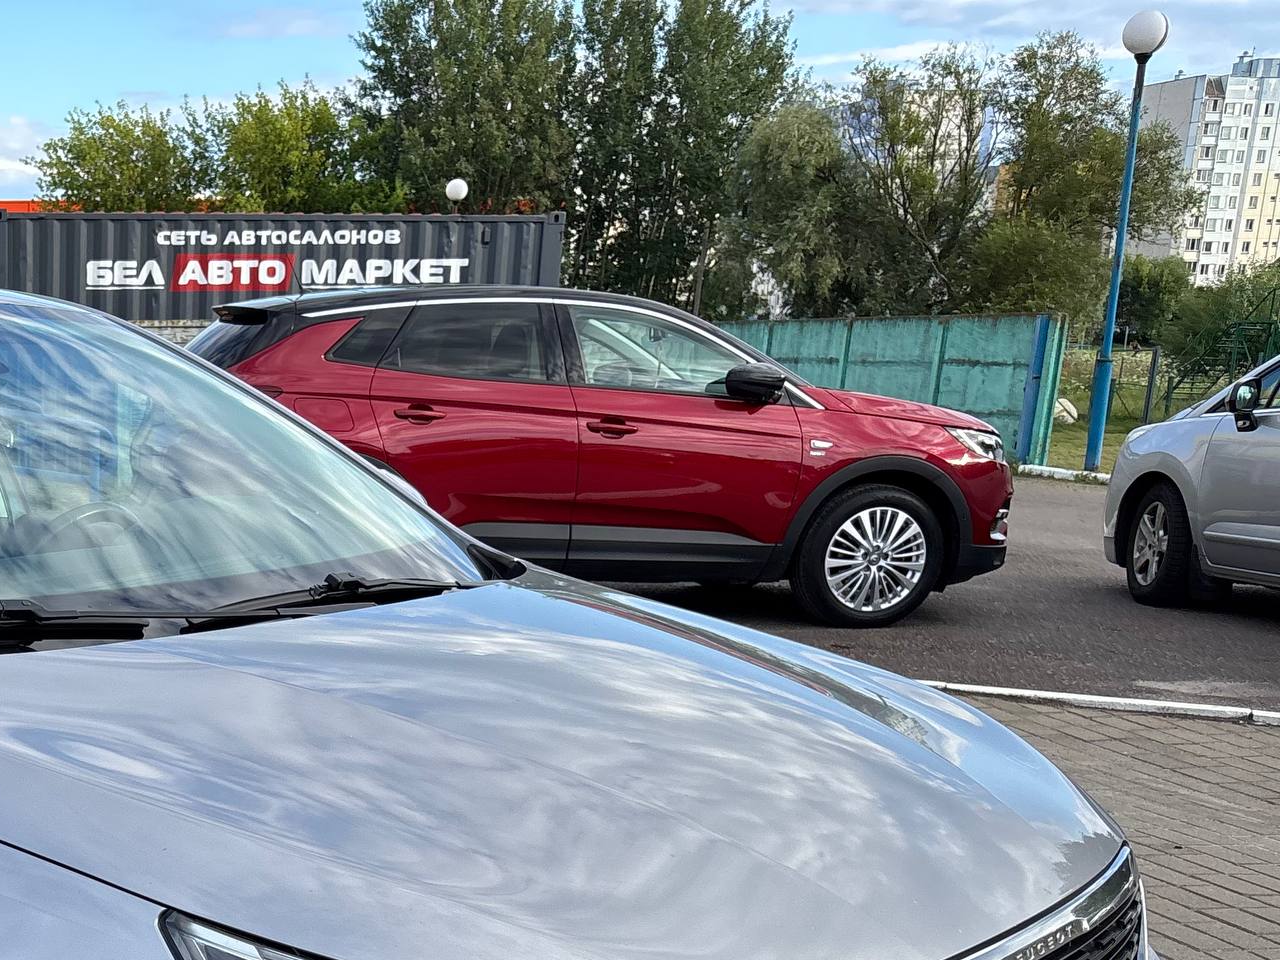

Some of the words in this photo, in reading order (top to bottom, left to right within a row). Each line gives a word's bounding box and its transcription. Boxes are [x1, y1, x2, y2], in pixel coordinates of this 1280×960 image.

[156, 229, 218, 247] СЕТЬ
[222, 229, 402, 246] АВТОСАЛОНОВ
[85, 259, 166, 286] БЕЛ
[177, 259, 287, 286] АВТО
[300, 258, 470, 286] МАРКЕТ
